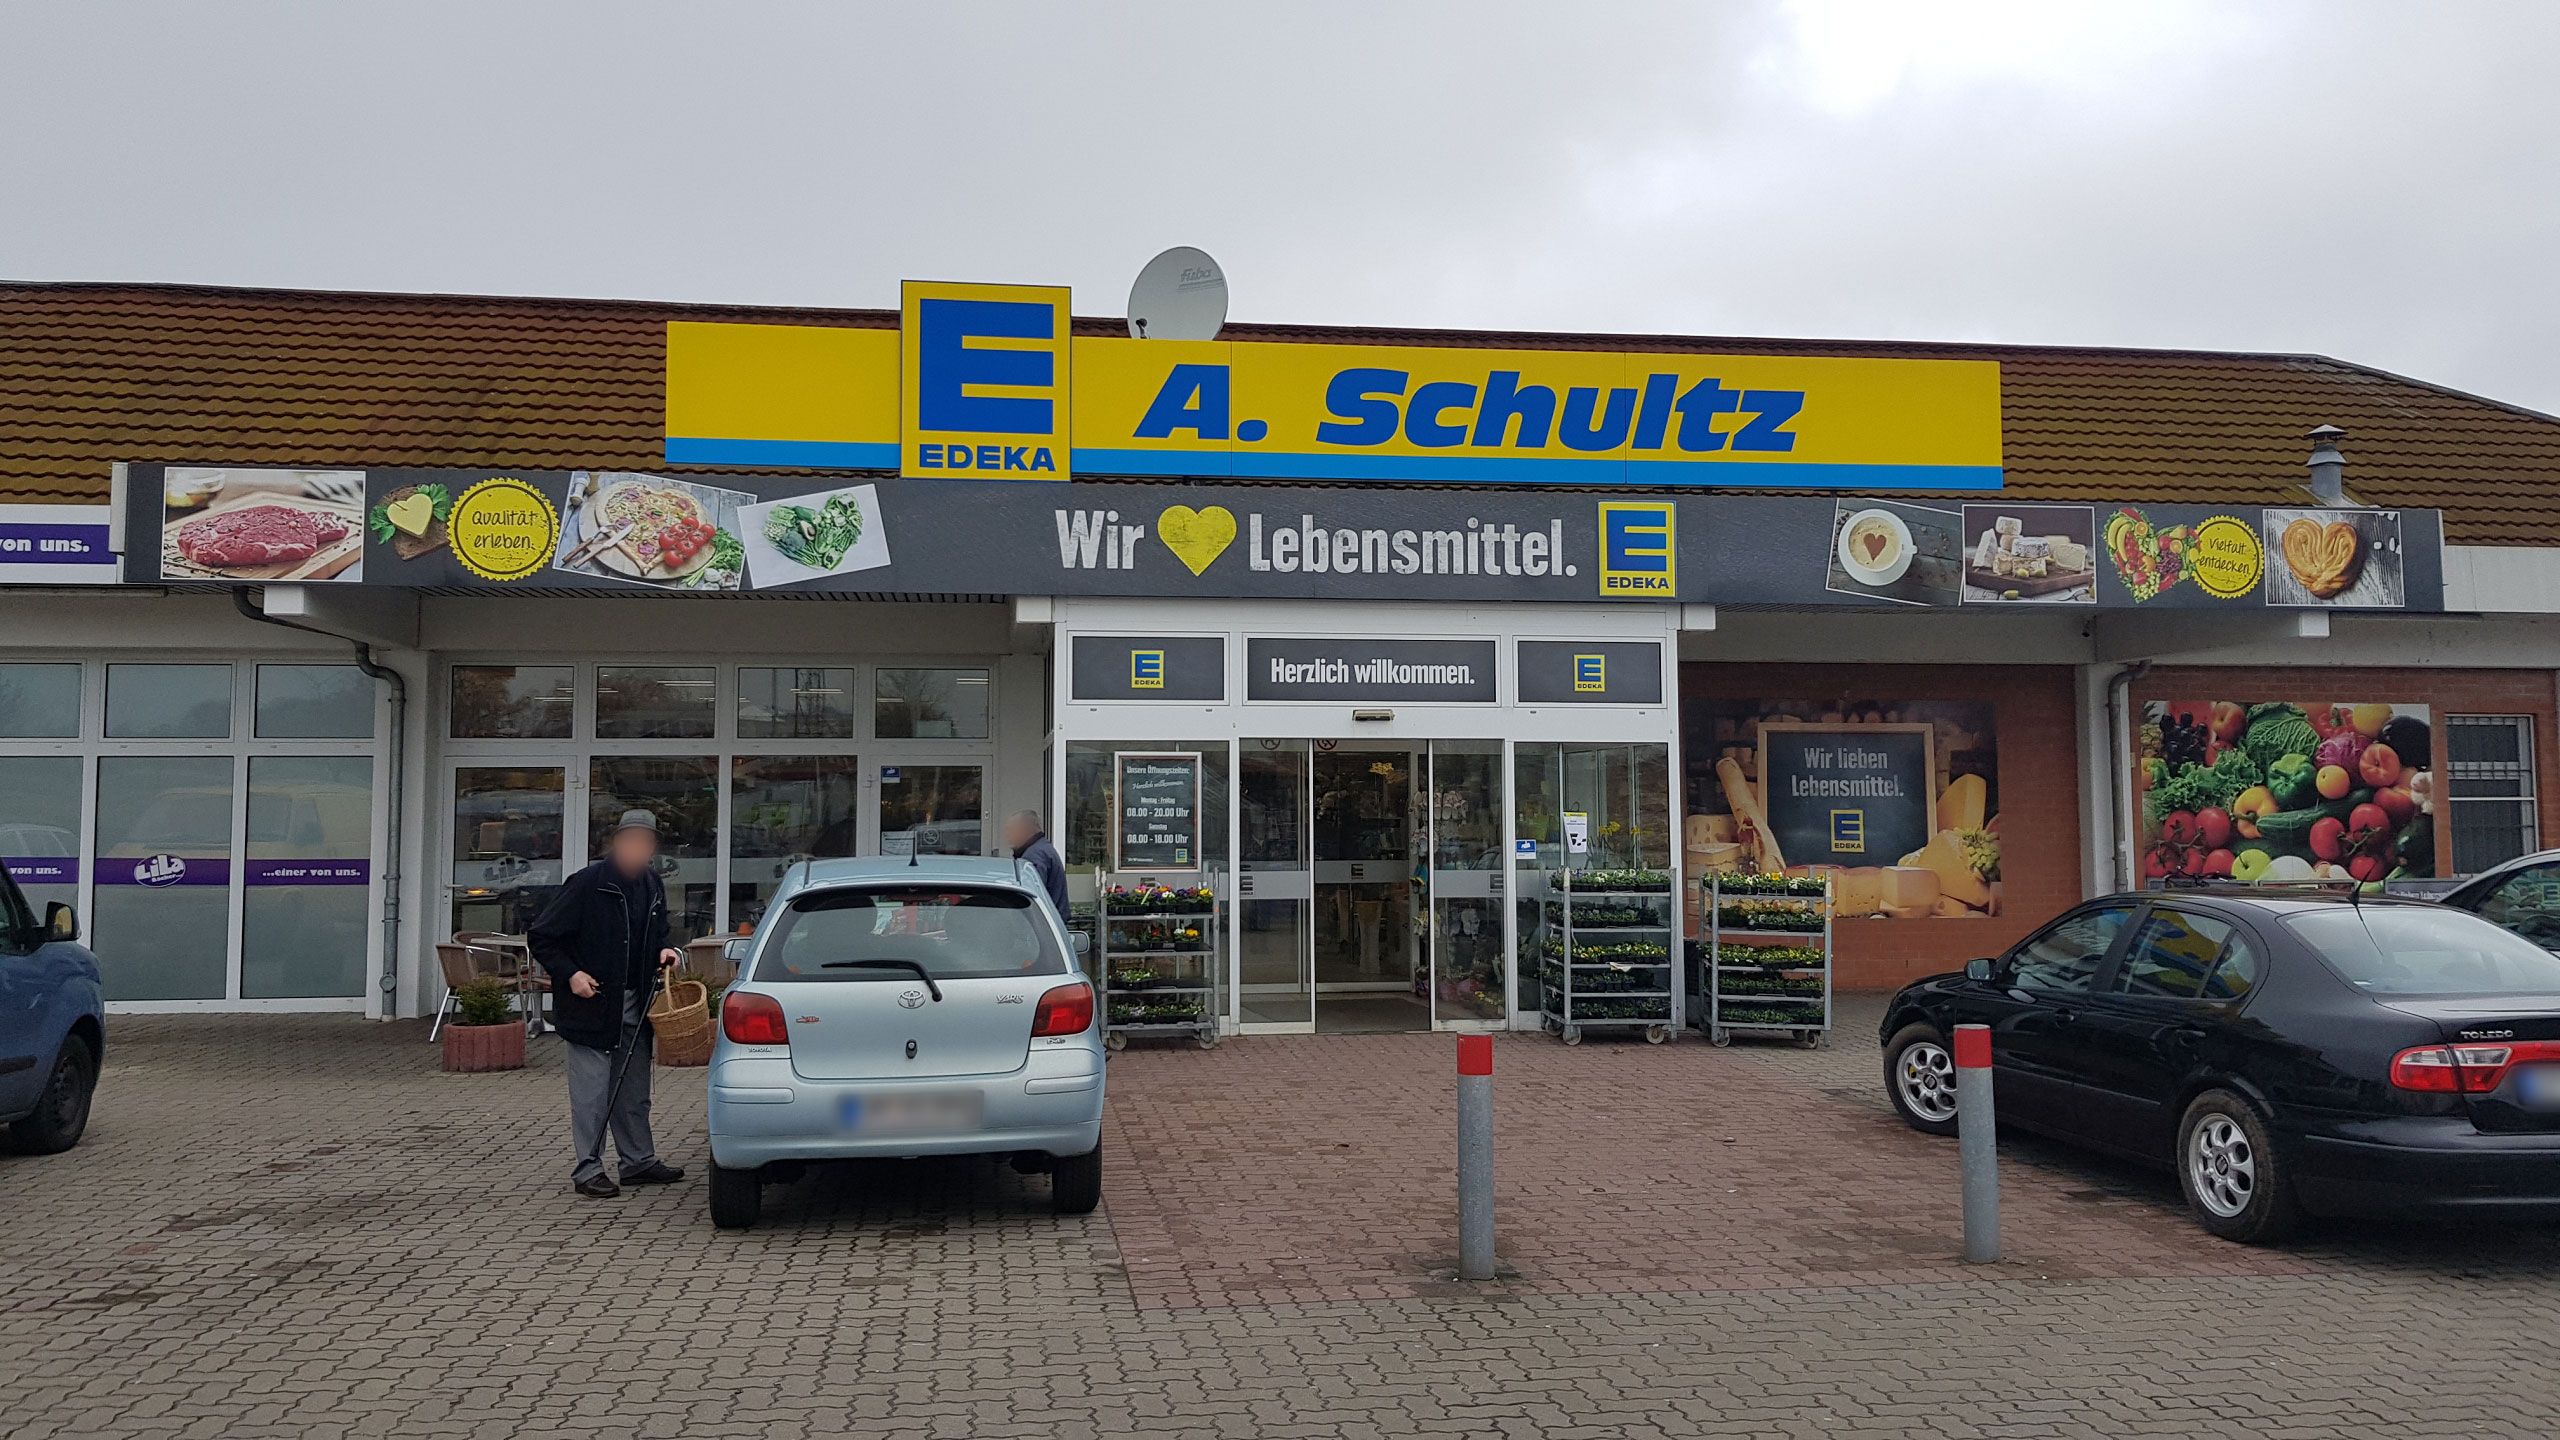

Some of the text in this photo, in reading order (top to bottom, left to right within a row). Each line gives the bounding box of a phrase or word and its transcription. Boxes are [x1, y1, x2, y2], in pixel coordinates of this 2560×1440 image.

[1132, 363, 1805, 453] A. Schultz
[919, 443, 1056, 472] EDEKA
[472, 510, 536, 526] Qualität
[40, 538, 90, 553] uns.
[1055, 509, 1577, 577] Wir Lebensmittel.
[1606, 576, 1670, 590] EDEKA
[1271, 657, 1476, 685] Herzlich willkommen.
[1804, 747, 1888, 769] Wir lieben
[1126, 766, 1147, 774] Unsere
[1791, 774, 1905, 798] Lebensmittel.
[1126, 807, 1148, 817] 08.00
[1154, 807, 1175, 817] 20.00
[1176, 807, 1190, 817] Uhr
[1127, 833, 1148, 844] 08.00
[1154, 833, 1174, 844] 18.00
[1175, 833, 1189, 844] Uhr
[1834, 842, 1862, 850] EDEKA
[10, 867, 62, 875] von uns.
[310, 868, 332, 876] von
[335, 868, 361, 876] uns.
[2459, 1030, 2514, 1039] TOLEDO
